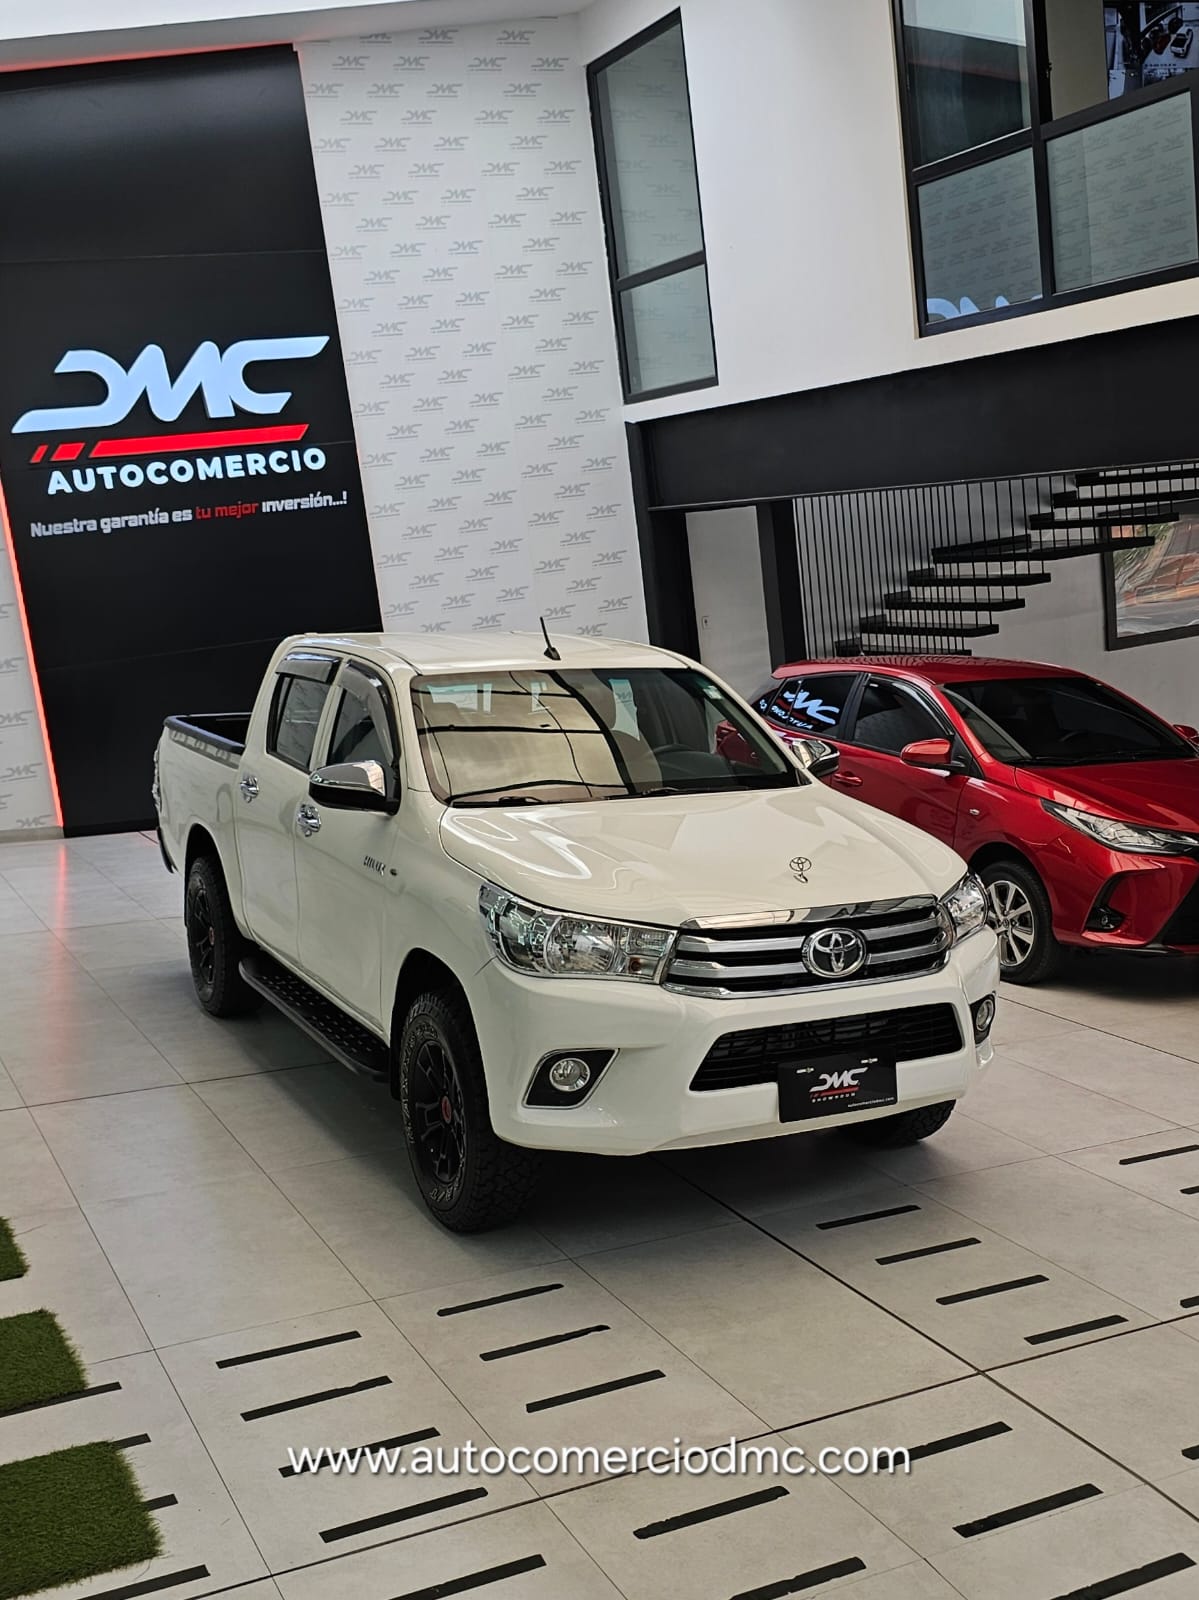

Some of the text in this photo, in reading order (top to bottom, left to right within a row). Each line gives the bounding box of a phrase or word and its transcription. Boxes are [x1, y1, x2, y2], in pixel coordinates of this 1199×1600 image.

[11, 335, 330, 434] DMC
[47, 447, 327, 495] AUTOCOMERCIO
[30, 518, 97, 537] Nuestra
[100, 507, 169, 534] garantía
[172, 508, 193, 523] es
[195, 506, 212, 520] tu
[214, 501, 259, 519] mejor
[809, 1066, 869, 1093] DMC
